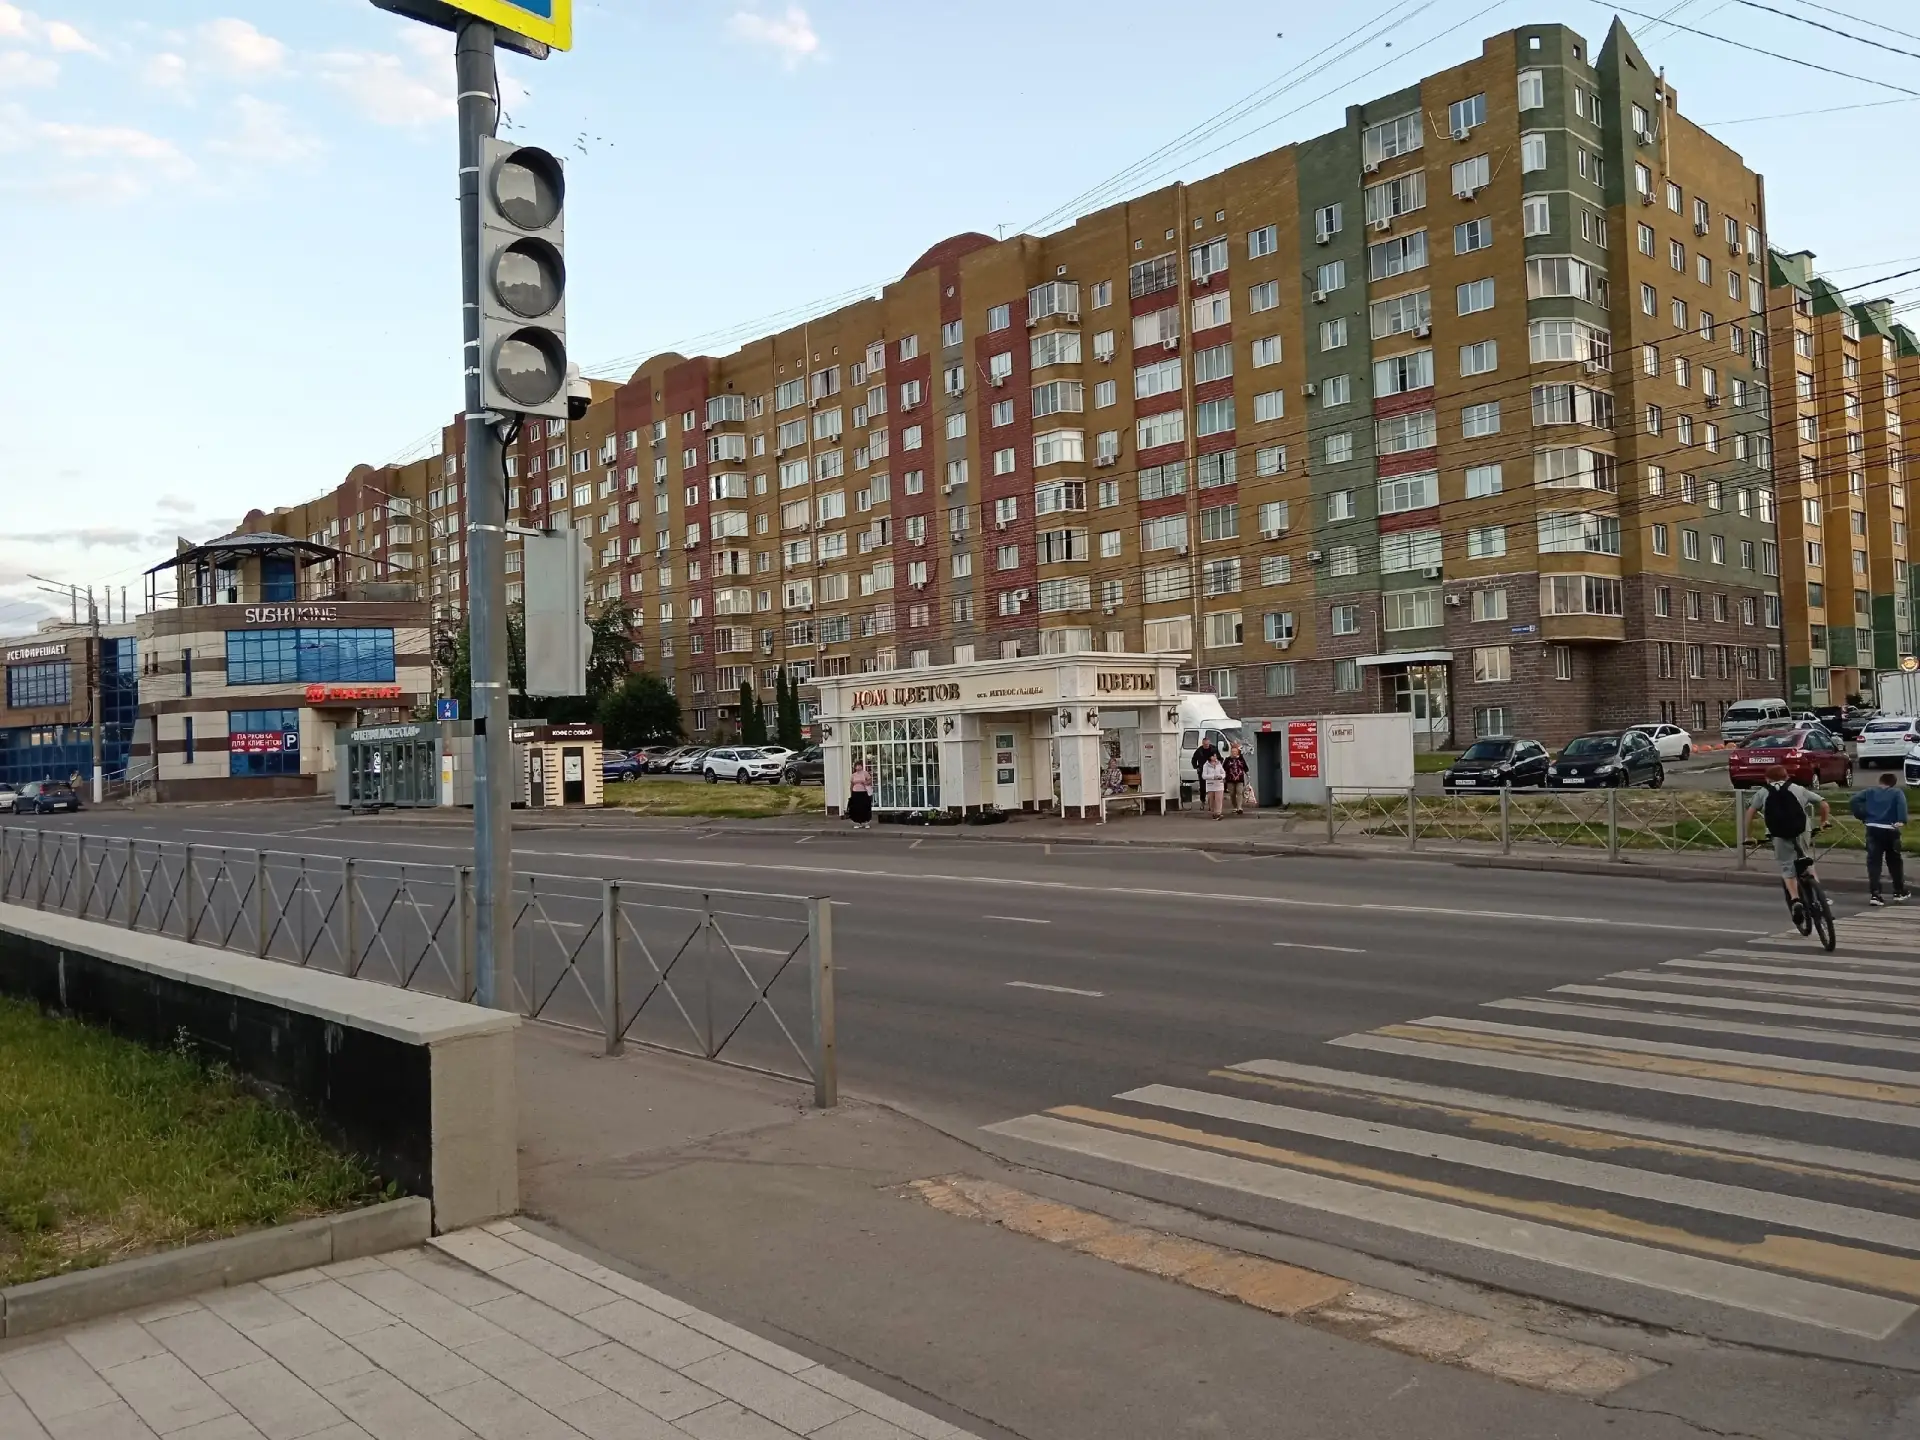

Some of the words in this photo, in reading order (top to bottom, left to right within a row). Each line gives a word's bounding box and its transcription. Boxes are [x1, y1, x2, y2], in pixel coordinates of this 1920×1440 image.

[245, 607, 295, 623] SUSHI
[1097, 673, 1156, 693] ЦВЕТЫ
[330, 686, 402, 699] МАГНИТ
[851, 688, 889, 711] ДОМ
[892, 683, 961, 706] ЦВЕТОВ
